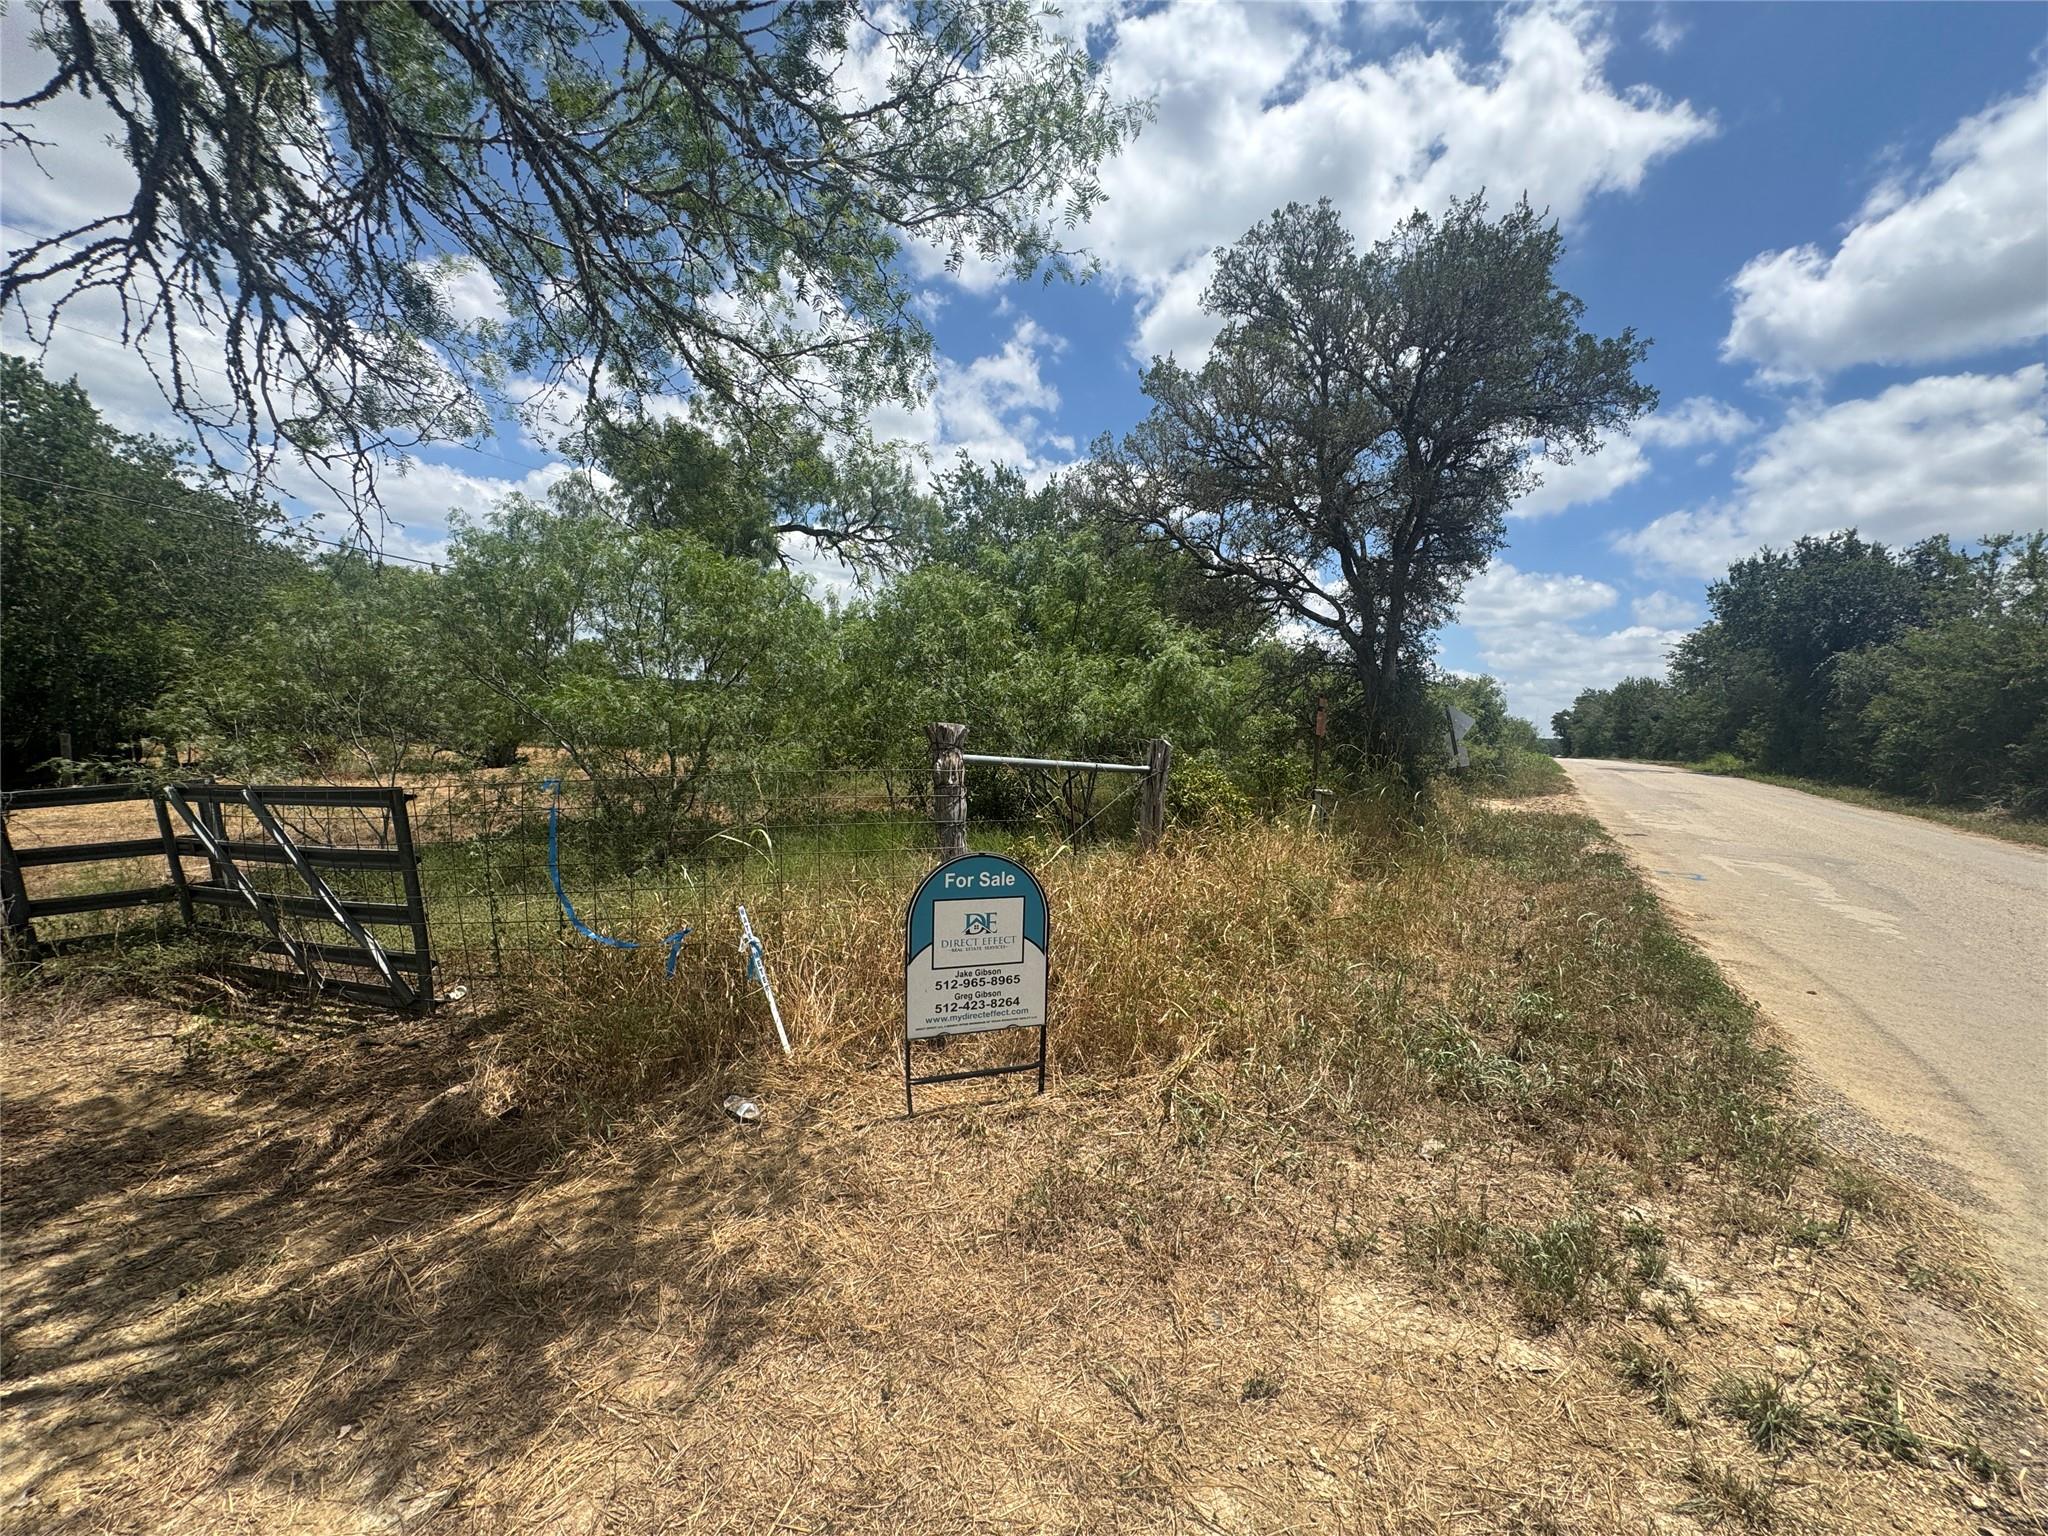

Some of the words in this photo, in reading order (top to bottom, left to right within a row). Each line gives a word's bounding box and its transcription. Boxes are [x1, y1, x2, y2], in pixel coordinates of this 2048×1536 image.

[944, 873, 974, 888] For
[979, 871, 1016, 887] Sale
[941, 938, 978, 949] DIRECT
[982, 935, 1017, 946] EFFECT
[955, 969, 973, 978] Jake
[974, 968, 1002, 977] Gibson
[935, 974, 1021, 991] 512-965-8965
[954, 992, 973, 1001] Greg
[974, 990, 1002, 999] Gibson
[935, 997, 1020, 1014] 512-423-8264
[925, 1007, 1029, 1024] www.mydirecteffect.com
